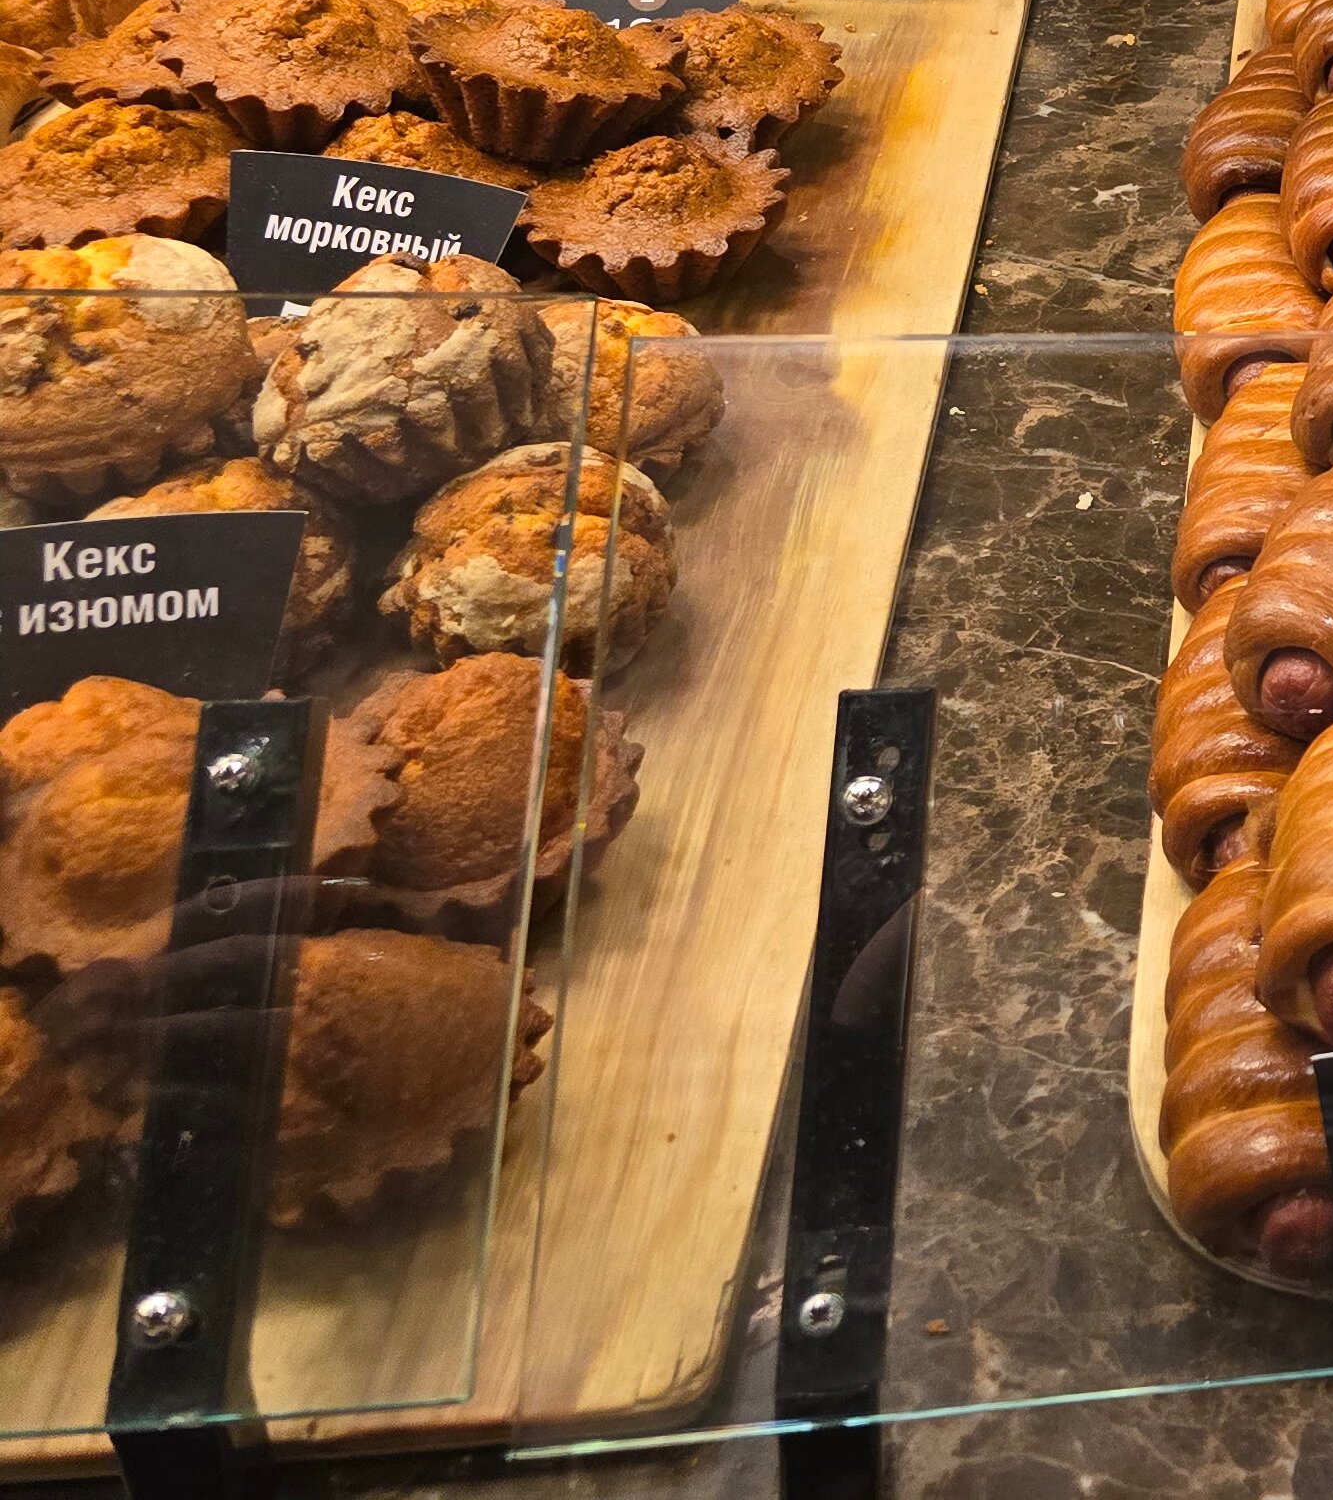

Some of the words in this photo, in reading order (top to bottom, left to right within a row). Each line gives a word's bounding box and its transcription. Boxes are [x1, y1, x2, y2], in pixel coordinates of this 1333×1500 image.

[331, 175, 415, 217] Кекс
[264, 214, 462, 263] морковный
[43, 541, 156, 582] Кекс
[19, 587, 220, 635] изюмом
